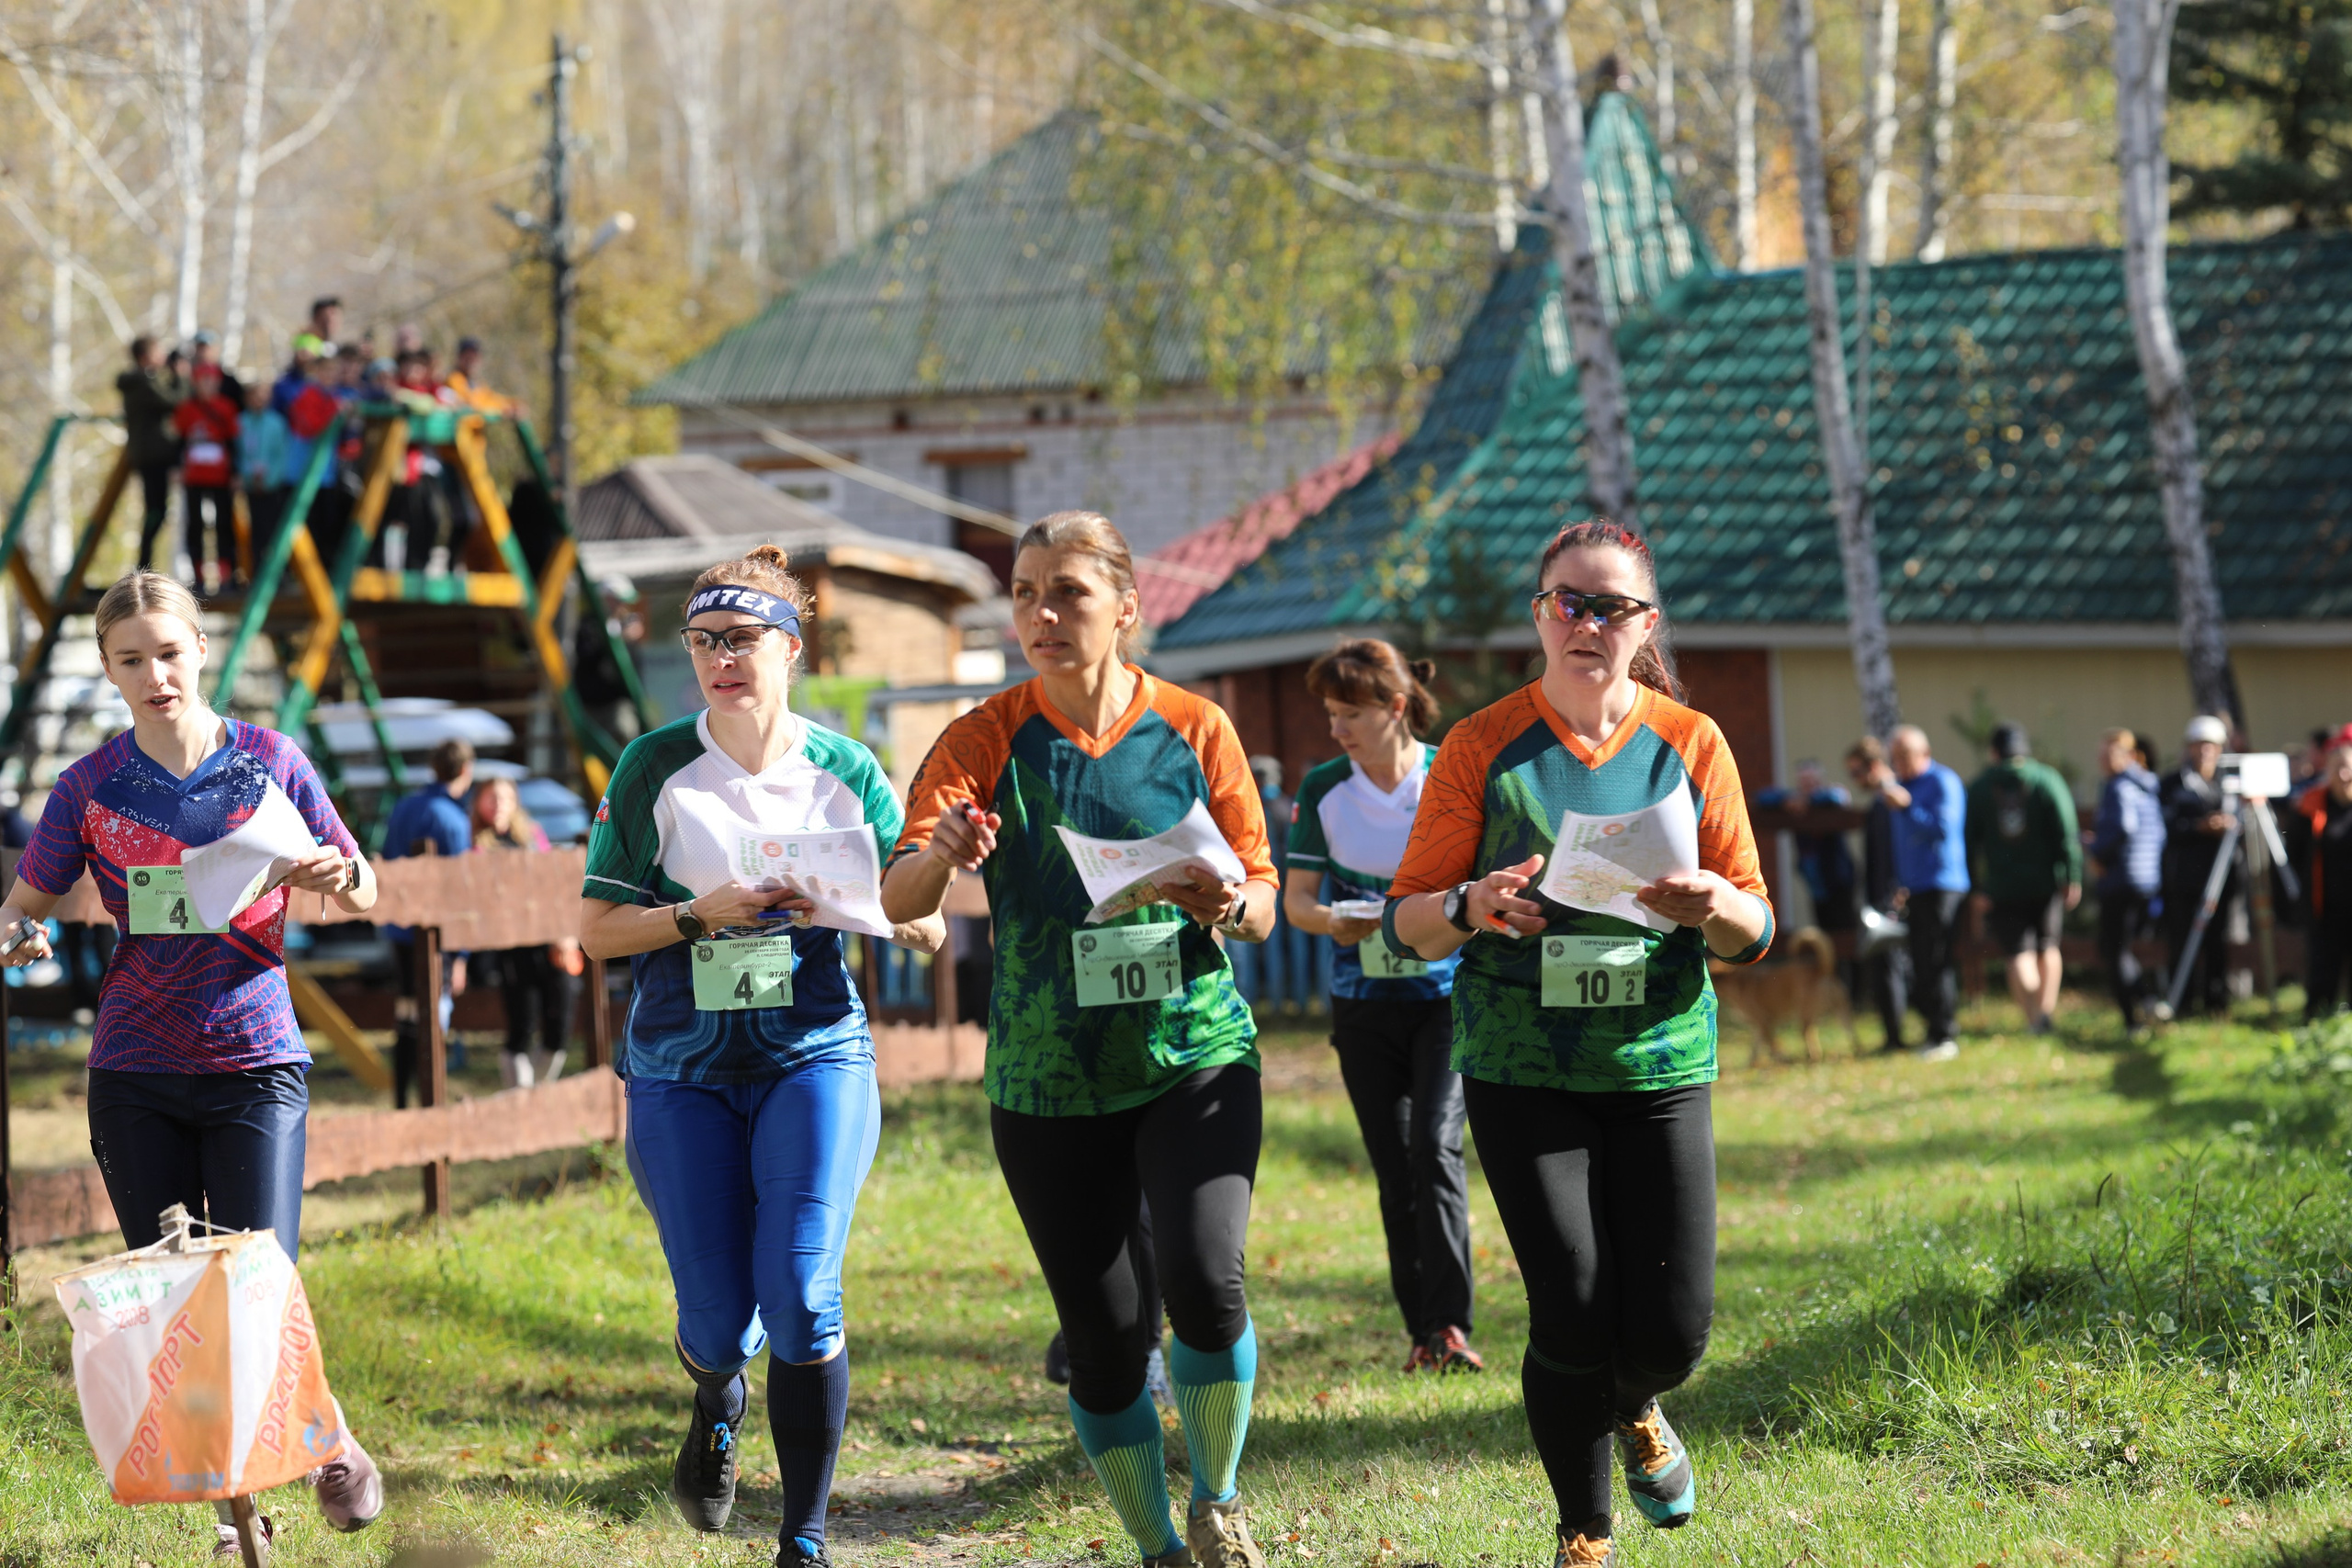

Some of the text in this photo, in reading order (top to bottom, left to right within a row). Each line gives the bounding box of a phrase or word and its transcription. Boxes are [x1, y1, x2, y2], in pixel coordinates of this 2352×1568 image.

[169, 897, 189, 930] 4
[1145, 928, 1174, 936] ДЕСЯТКА
[768, 970, 790, 978] ЭТАП
[1155, 960, 1178, 969] ЭТАП
[1382, 953, 1403, 974] 12
[734, 971, 754, 1005] 4
[778, 979, 786, 1002] 1
[1110, 962, 1147, 999] 10
[1164, 969, 1172, 994] 1
[1576, 969, 1610, 1005] 10
[1625, 978, 1635, 1002] 2
